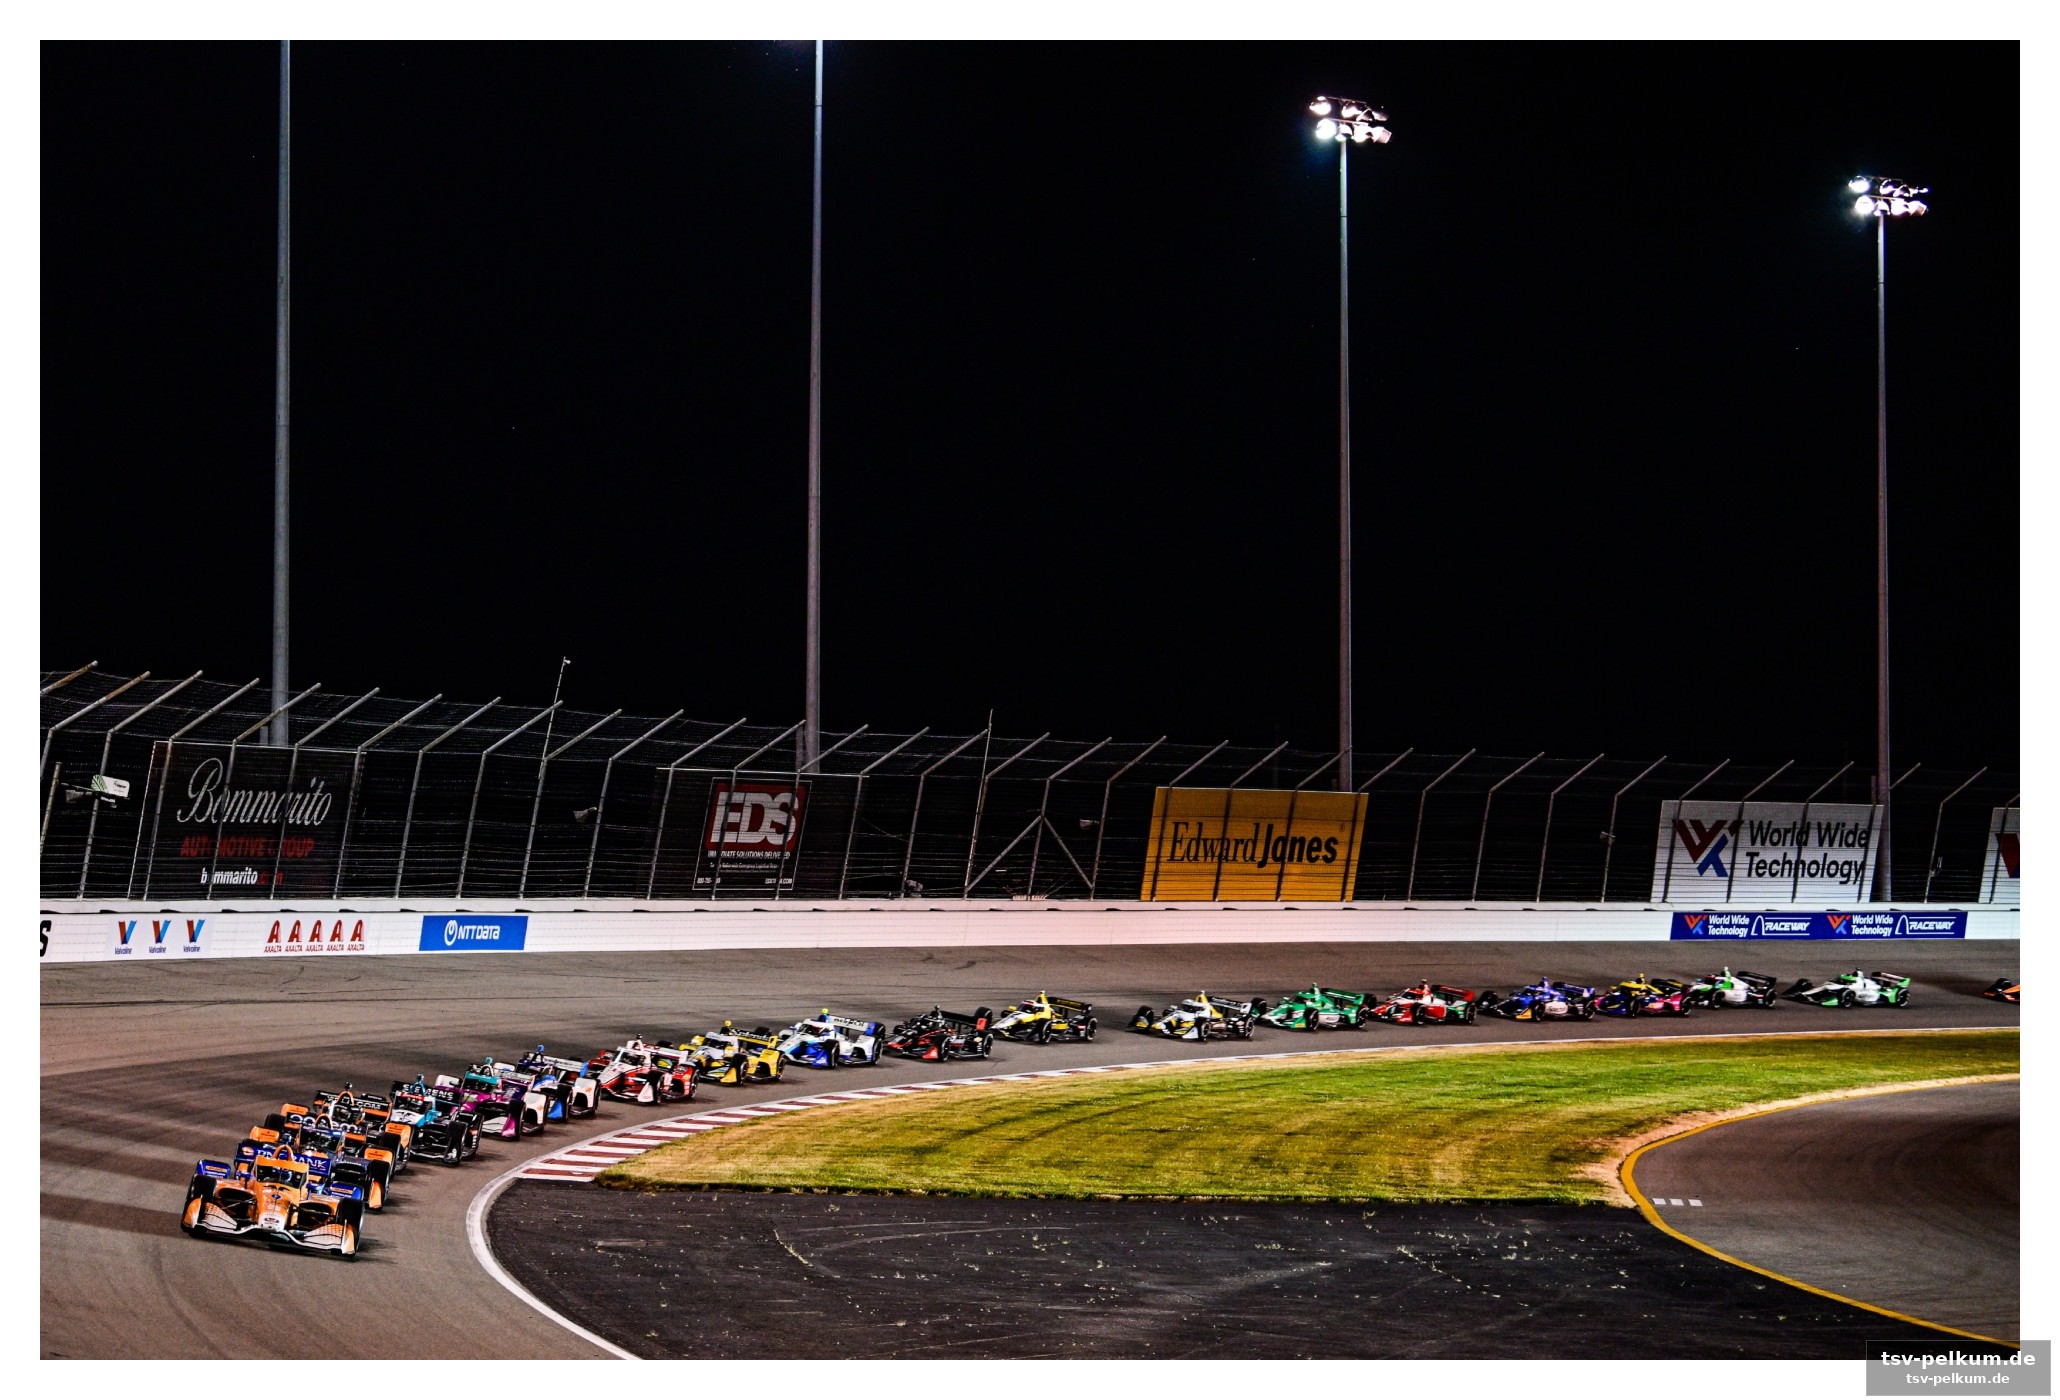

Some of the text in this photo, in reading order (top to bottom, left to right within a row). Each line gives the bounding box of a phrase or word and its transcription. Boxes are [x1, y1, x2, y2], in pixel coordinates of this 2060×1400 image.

[710, 791, 799, 845] EDS
[1749, 820, 1871, 848] World Wide
[1745, 851, 1864, 885] Technology
[1708, 915, 1750, 925] World Wide
[1852, 915, 1894, 924] World Wide
[1764, 922, 1810, 931] RACEWAY
[1909, 921, 1955, 930] RACEWAY
[1708, 925, 1749, 937] Technology
[1851, 925, 1892, 936] Technology
[264, 945, 282, 953] AXALTA
[285, 944, 303, 952] AXALTA
[305, 944, 324, 952] AXALTA
[326, 944, 344, 952] AXALTA
[347, 943, 365, 952] AXALTA
